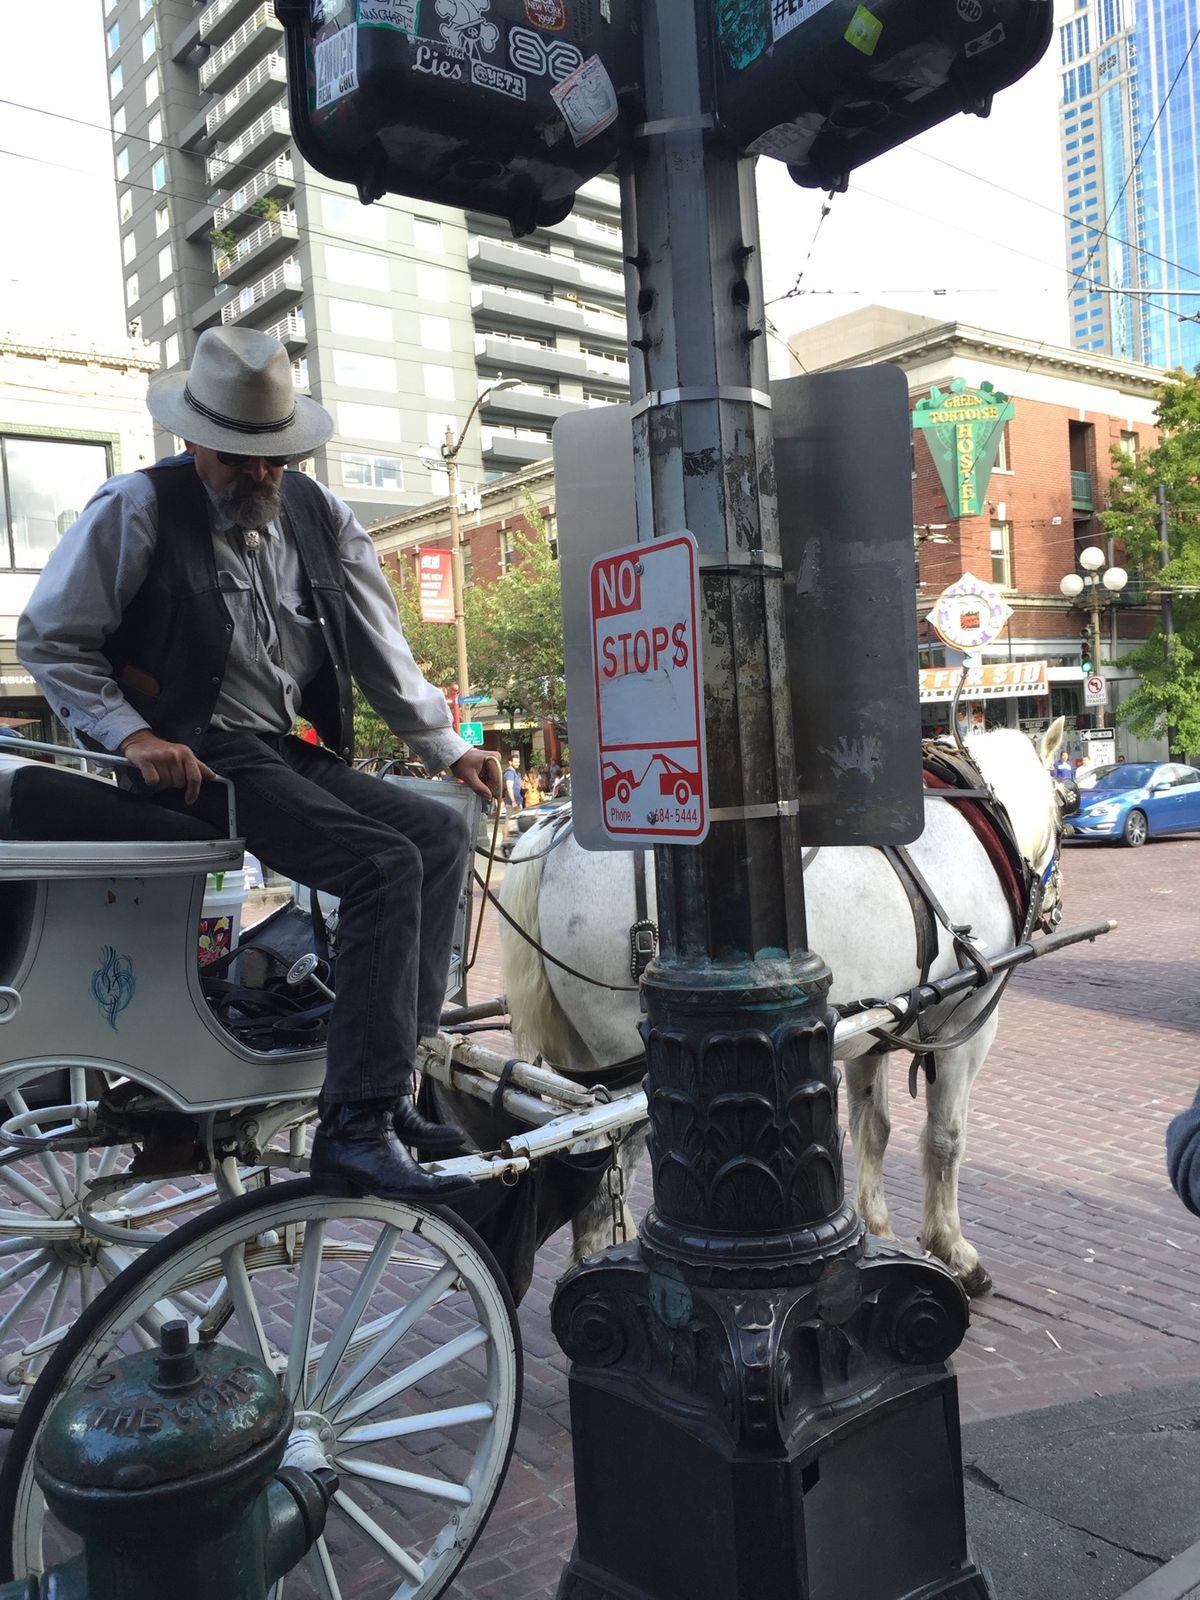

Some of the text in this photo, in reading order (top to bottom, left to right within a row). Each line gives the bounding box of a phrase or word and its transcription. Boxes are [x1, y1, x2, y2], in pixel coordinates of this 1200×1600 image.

[527, 1, 542, 11] NEW
[543, 4, 563, 15] YORK
[412, 45, 462, 80] Lies
[339, 72, 354, 93] CULT
[944, 394, 982, 408] GREEN
[929, 407, 999, 424] TORTOISE
[957, 424, 975, 515] HOSTEL
[598, 559, 637, 612] NO
[602, 621, 689, 679] STOPS
[611, 807, 698, 823] Phone 684-5444
[91, 1406, 160, 1428] THE
